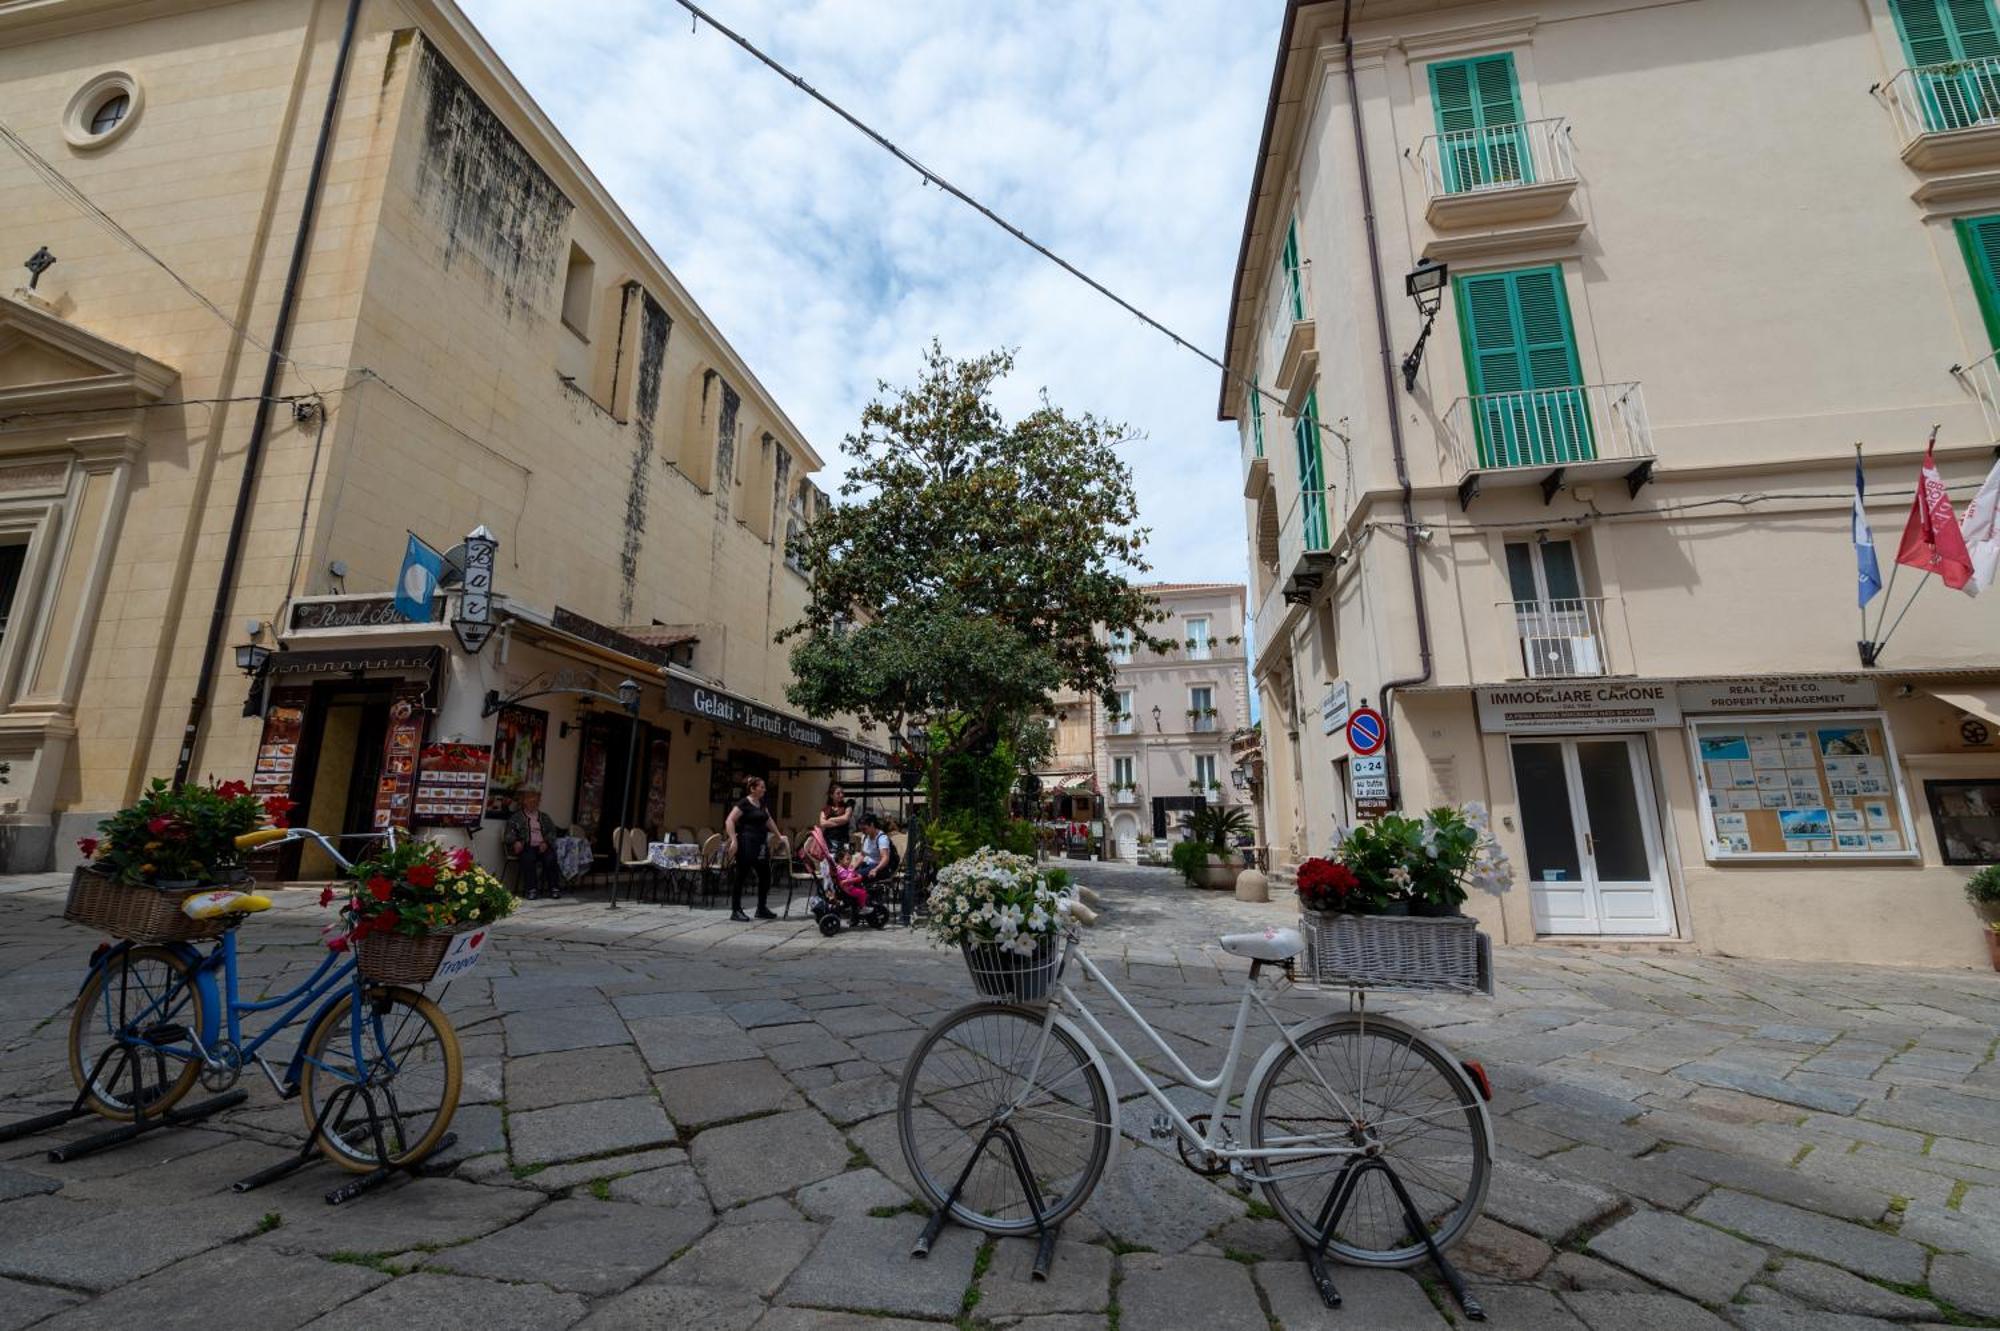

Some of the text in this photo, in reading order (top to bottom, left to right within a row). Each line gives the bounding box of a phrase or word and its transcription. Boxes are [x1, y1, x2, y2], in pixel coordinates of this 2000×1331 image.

[466, 543, 492, 614] Bar
[1597, 686, 1665, 701] CARONE
[1729, 685, 1755, 694] REAL
[1801, 683, 1820, 692] CO.
[1711, 694, 1845, 707] PROPERTY MANAGEMENT
[693, 689, 822, 745] Gelati Tartufi Granite
